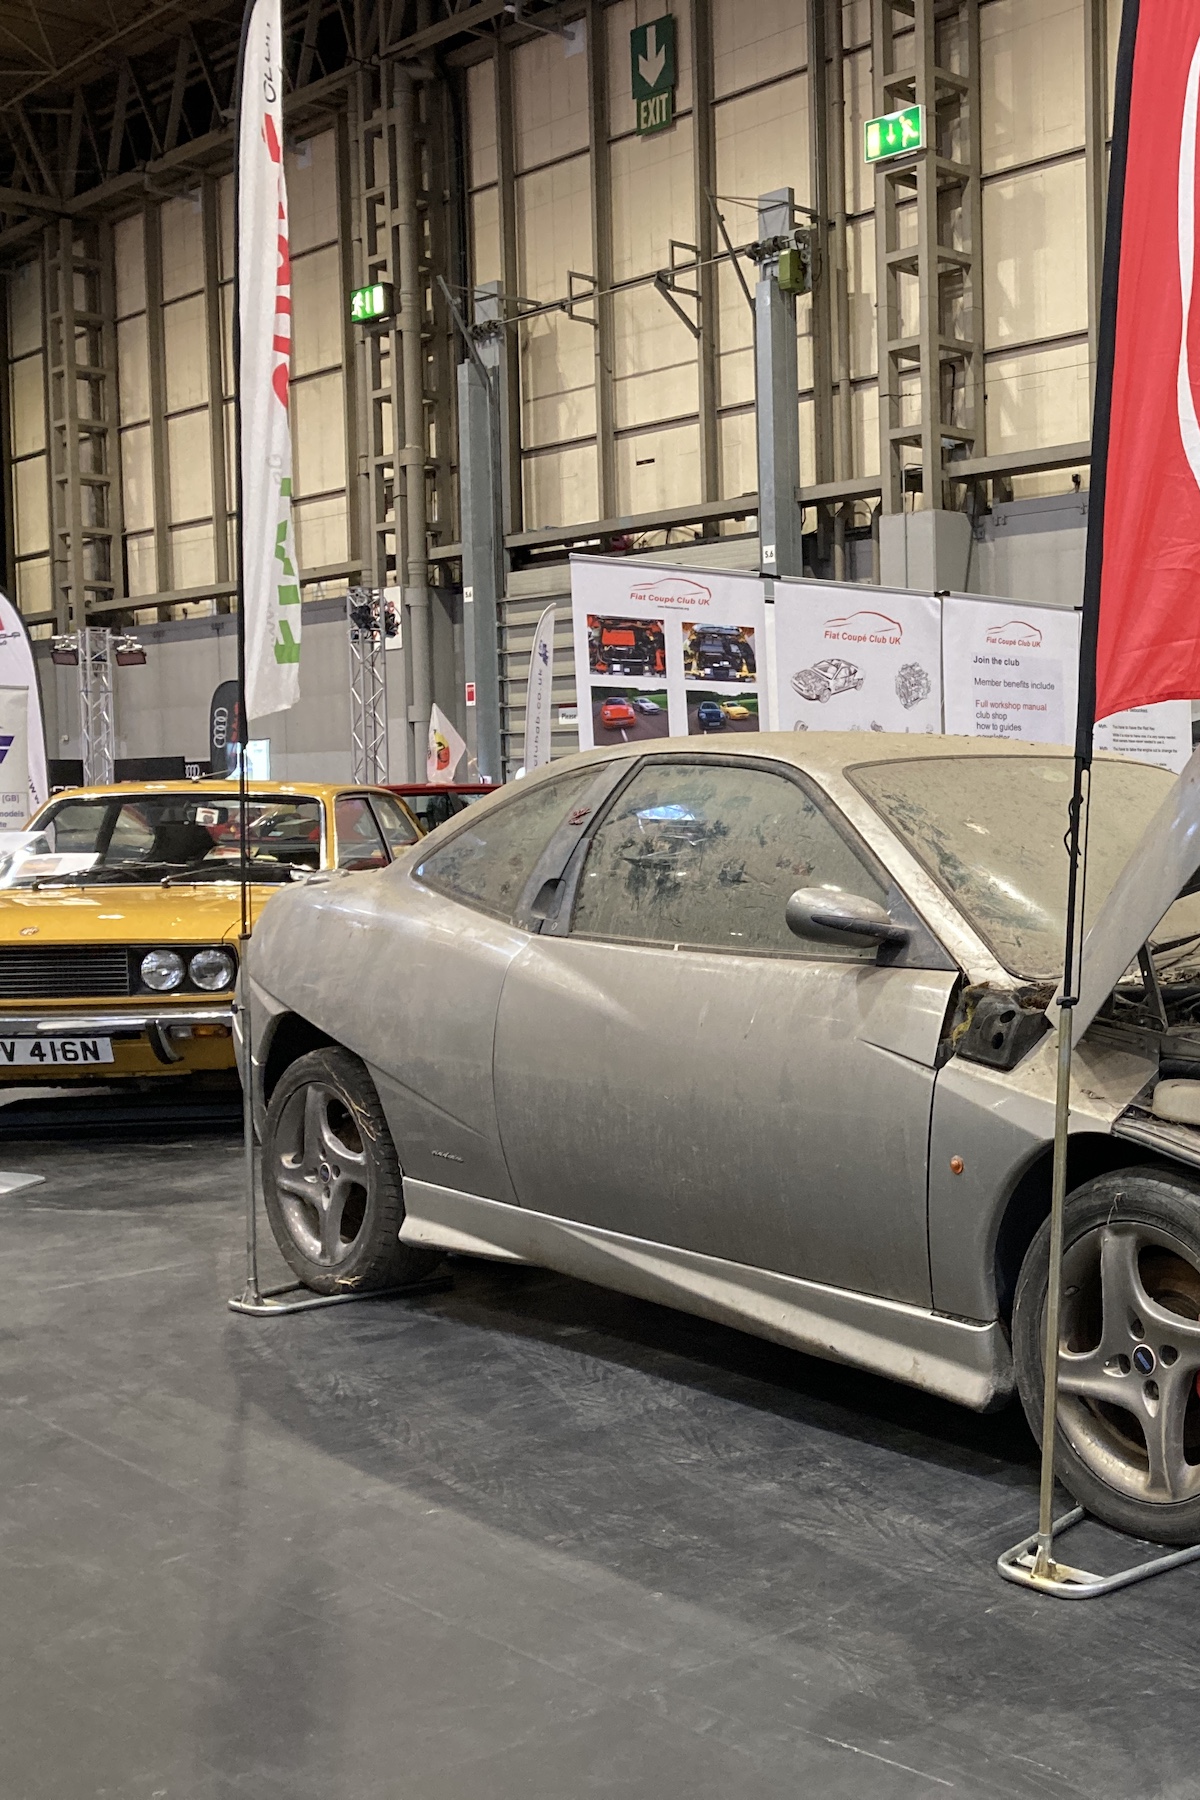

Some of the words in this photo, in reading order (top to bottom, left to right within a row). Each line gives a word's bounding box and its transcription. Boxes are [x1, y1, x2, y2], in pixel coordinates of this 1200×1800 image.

[640, 92, 669, 130] EXIT
[630, 592, 646, 601] Fiat
[648, 594, 675, 604] Coupé
[676, 596, 696, 605] Club
[698, 598, 711, 606] UK
[824, 630, 840, 640] Fiat
[841, 632, 867, 644] Coupé
[869, 634, 887, 644] Club
[889, 636, 901, 645] UK
[986, 636, 998, 644] Fiat
[1018, 638, 1031, 647] Club
[1032, 640, 1041, 648] UK
[973, 656, 990, 665] Join
[991, 657, 1003, 666] the
[1004, 658, 1020, 667] club
[974, 677, 1002, 687] Member
[1003, 679, 1030, 689] benefits
[1031, 680, 1055, 690] include
[975, 699, 988, 708] Full
[989, 700, 1022, 711] workshop
[1022, 702, 1048, 711] manual
[975, 711, 991, 719] club
[991, 711, 1008, 721] shop
[976, 721, 991, 730] how
[992, 723, 999, 731] to
[999, 723, 1022, 733] guides
[29, 1041, 101, 1062] 416N
